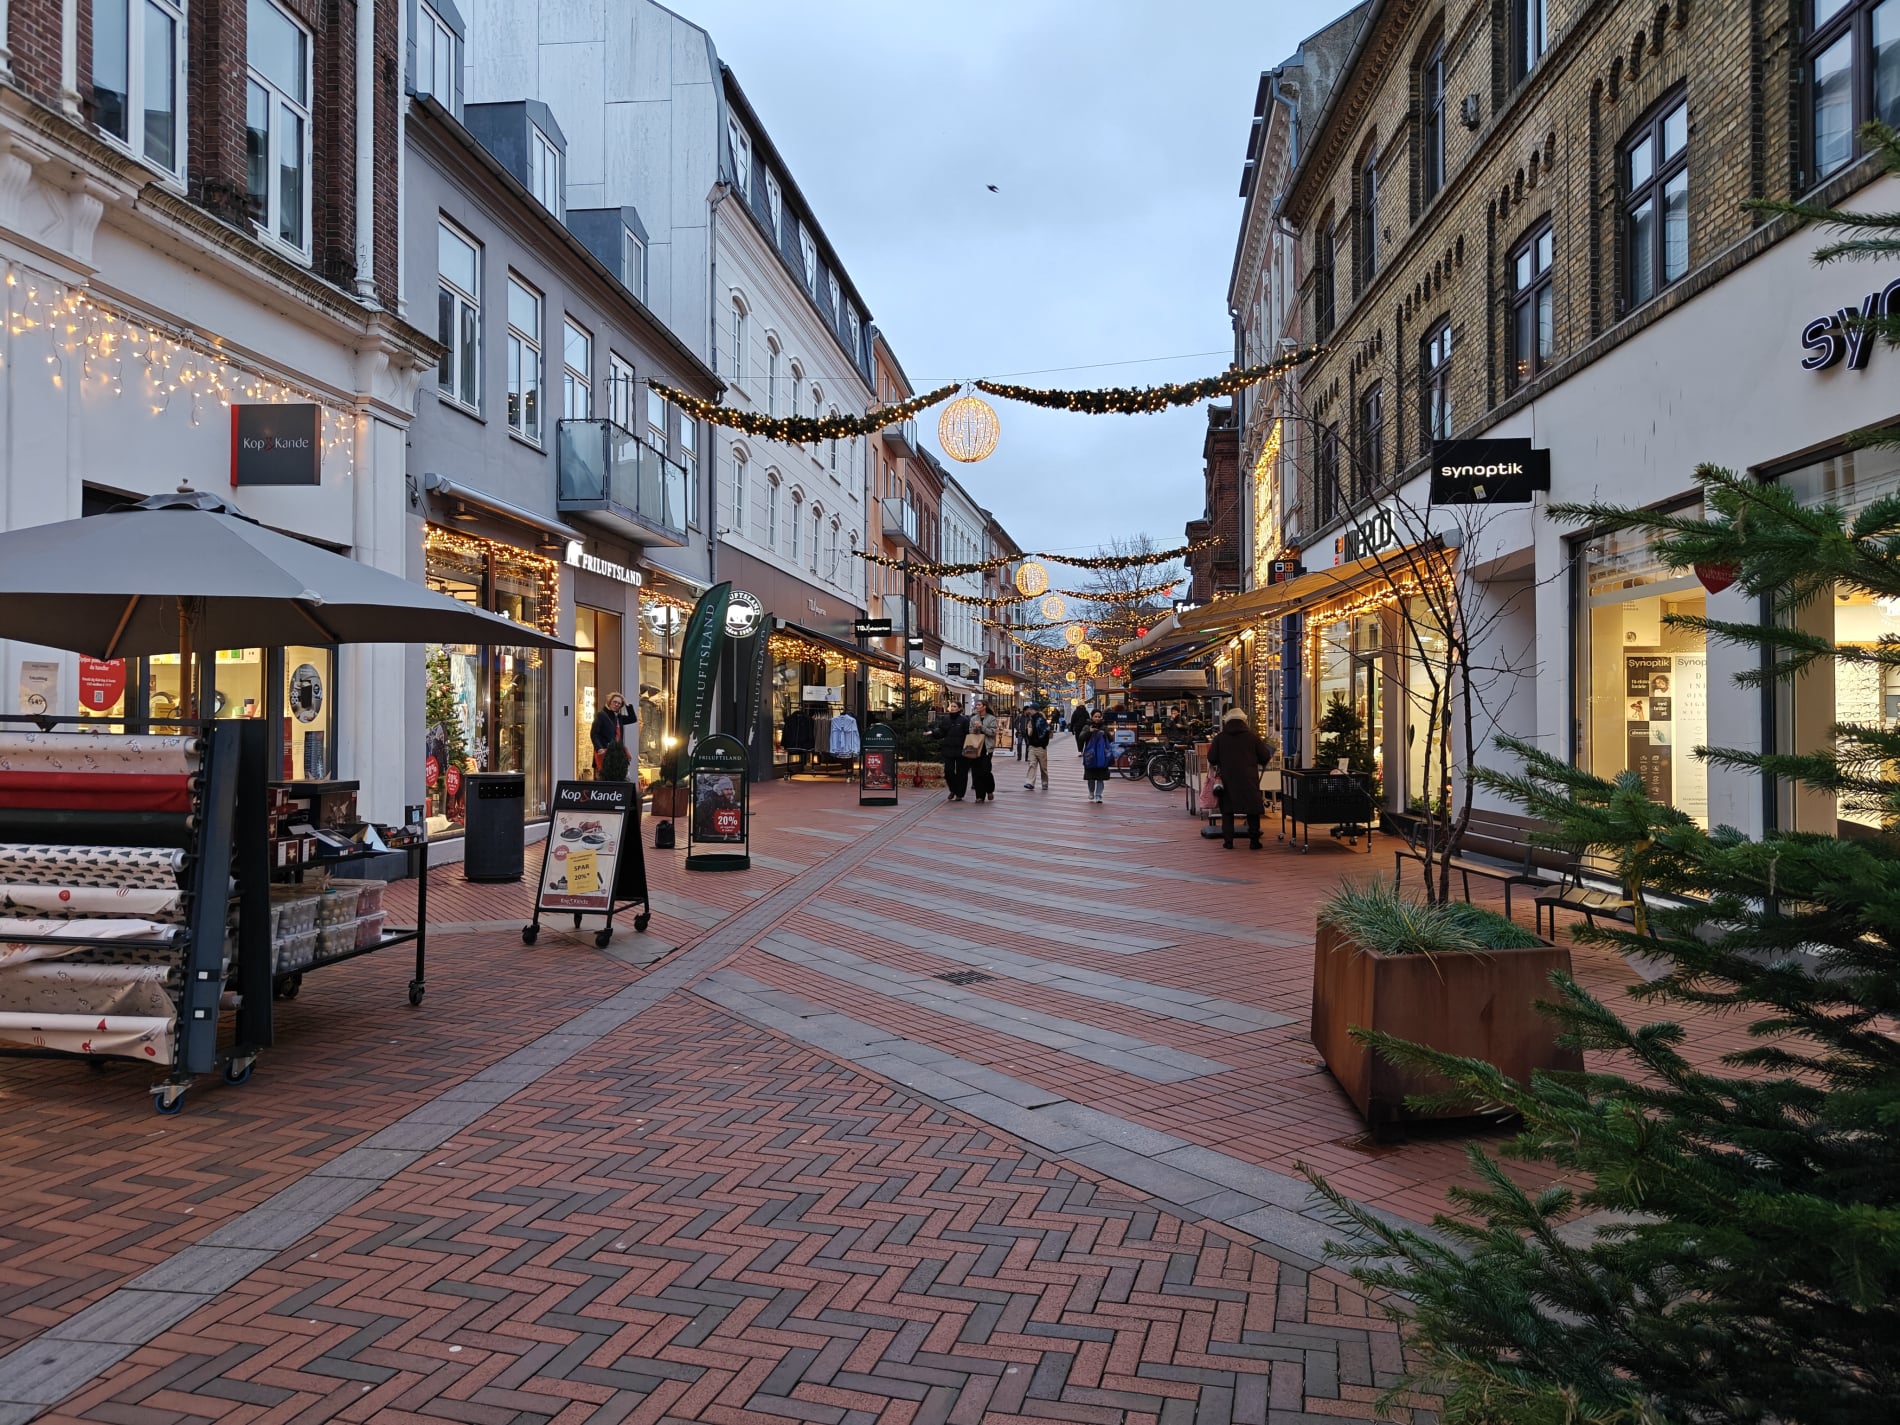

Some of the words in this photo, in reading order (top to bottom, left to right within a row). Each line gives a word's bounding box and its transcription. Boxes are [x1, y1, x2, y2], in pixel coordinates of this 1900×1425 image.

[243, 437, 265, 451] Kop
[275, 437, 309, 449] Kande
[1441, 463, 1523, 478] synoptik
[582, 553, 642, 587] FRILUFTSLAND
[693, 604, 715, 728] FRILUFTSLAND
[1628, 658, 1670, 668] Synoptik
[561, 789, 581, 802] Kop
[590, 790, 622, 801] Kande
[717, 815, 738, 825] 20%
